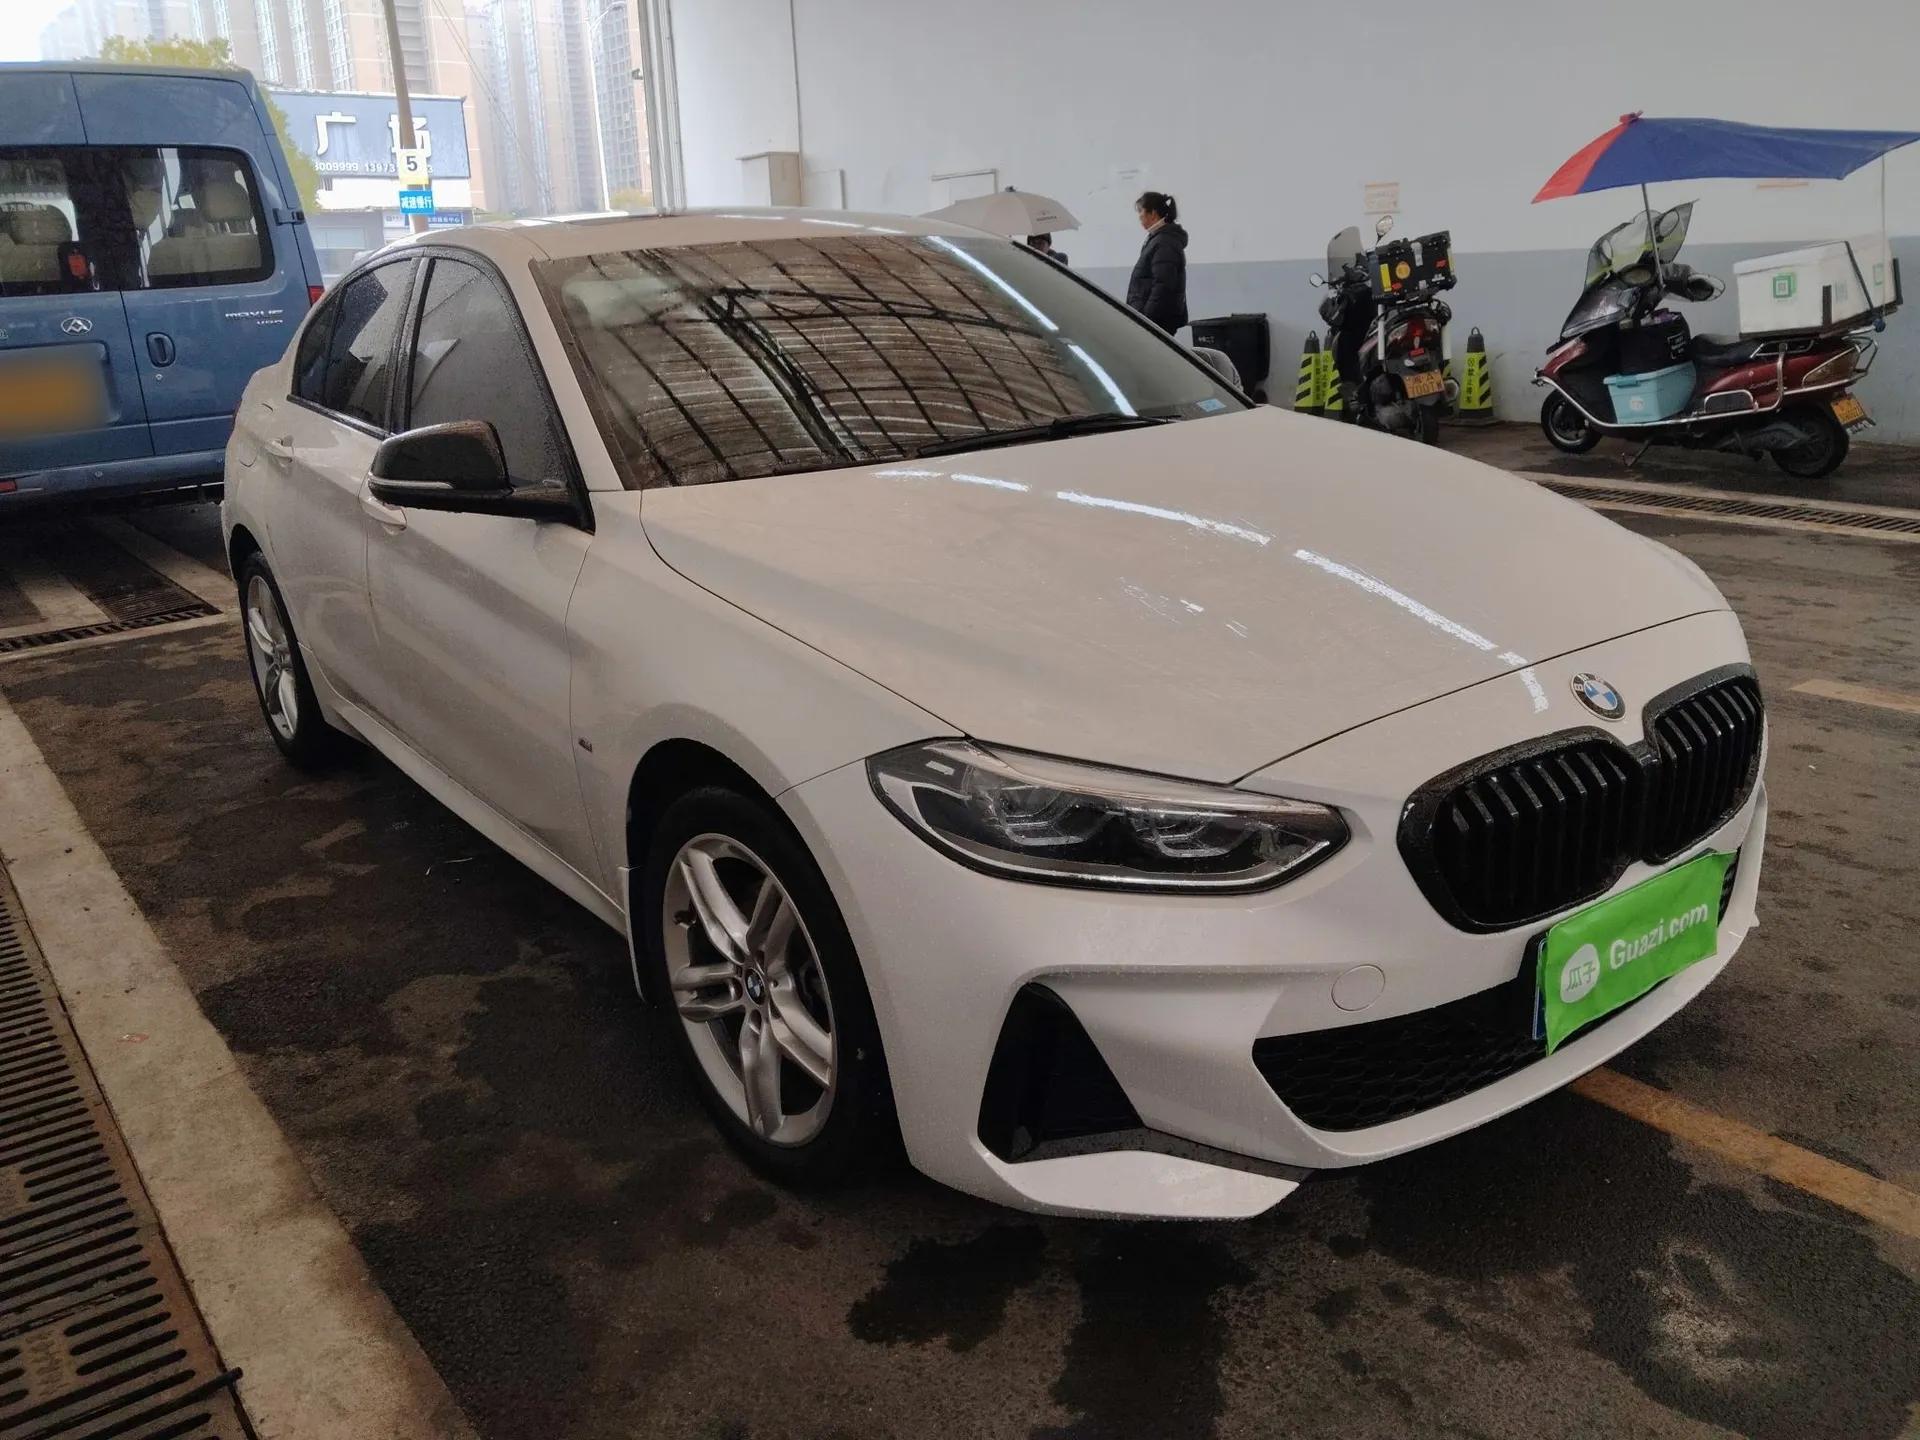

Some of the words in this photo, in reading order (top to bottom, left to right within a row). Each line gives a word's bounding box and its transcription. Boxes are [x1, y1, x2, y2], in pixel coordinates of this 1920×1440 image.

[406, 155, 418, 172] 5
[1610, 904, 1709, 970] Guazi.com
[1567, 961, 1596, 992] 瓜子
